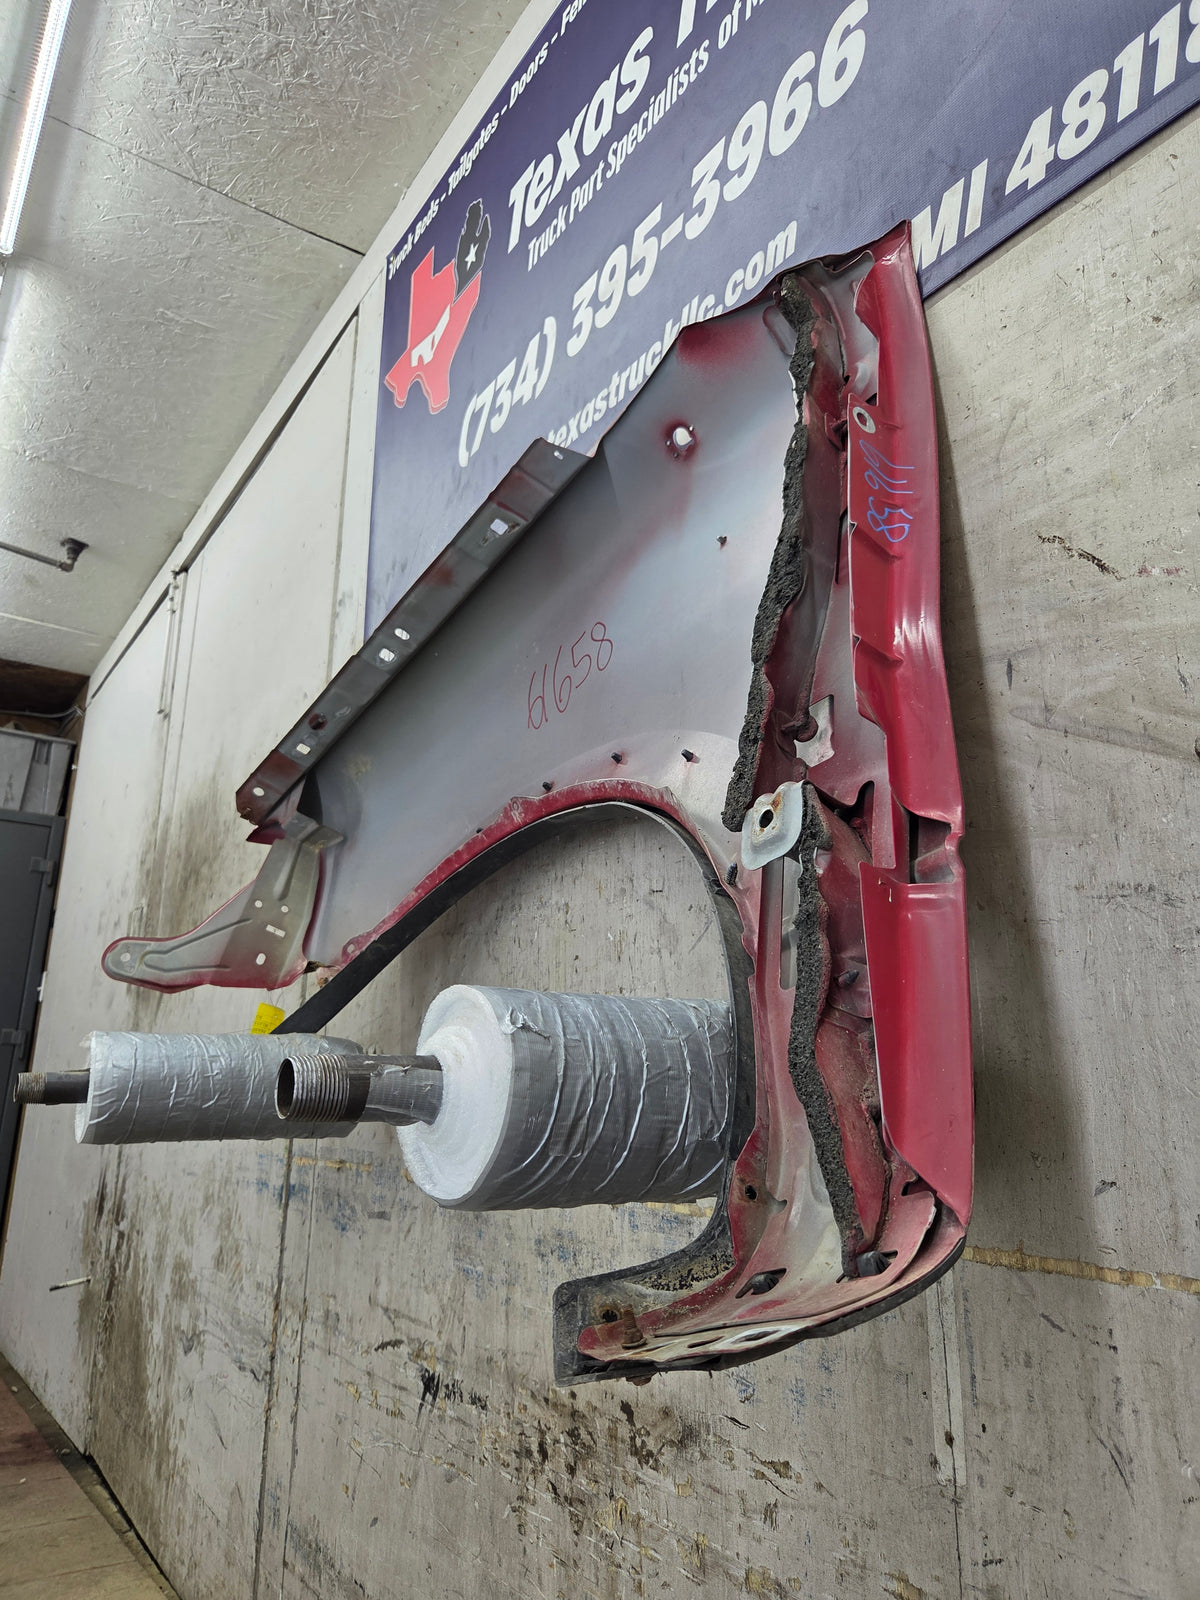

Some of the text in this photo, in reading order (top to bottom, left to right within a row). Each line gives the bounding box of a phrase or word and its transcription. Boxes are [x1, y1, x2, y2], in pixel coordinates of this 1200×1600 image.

[388, 232, 414, 280] Truck
[413, 198, 439, 245] Beds
[448, 111, 500, 195] Tailgates
[509, 41, 549, 109] Doors
[458, 0, 869, 468] (734) 395-3966
[507, 26, 654, 254] Texas
[527, 204, 569, 272] Truck
[569, 159, 605, 224] Part
[606, 39, 710, 179] Specialists
[718, 0, 742, 49] of
[911, 158, 988, 273] MI
